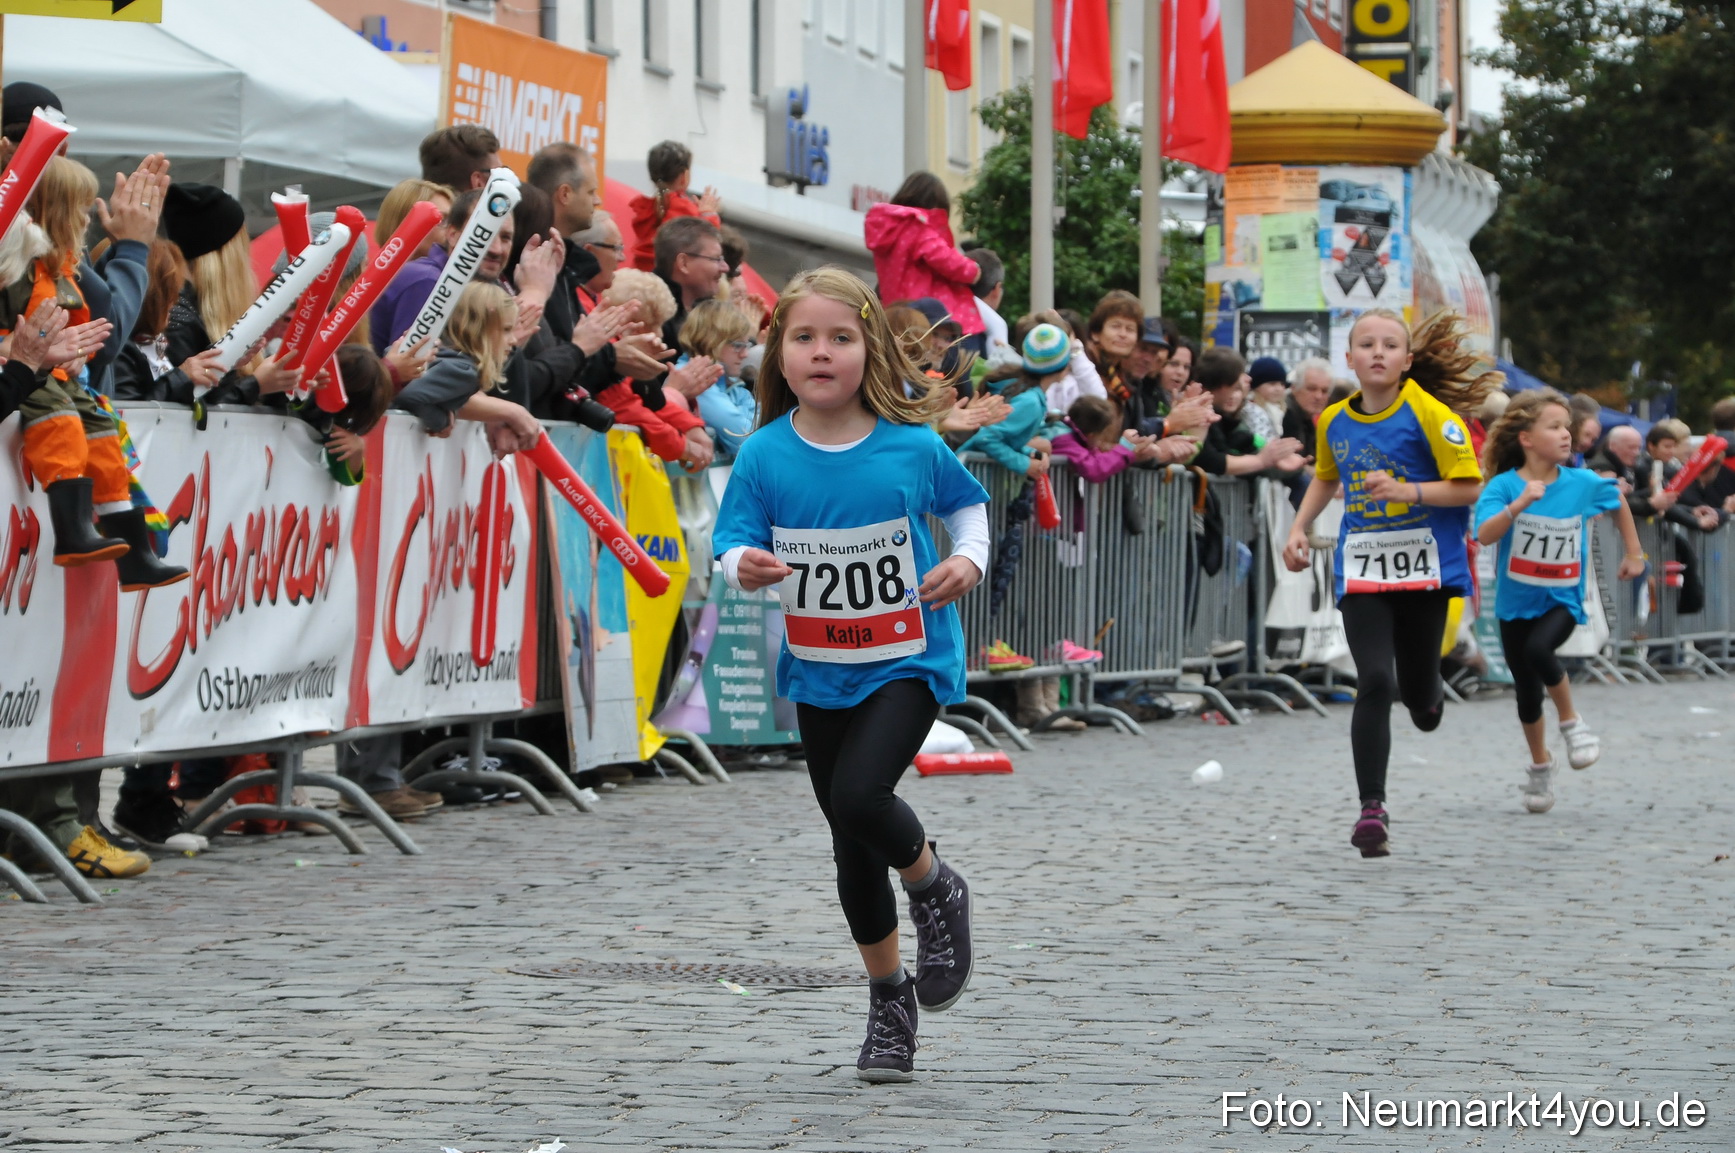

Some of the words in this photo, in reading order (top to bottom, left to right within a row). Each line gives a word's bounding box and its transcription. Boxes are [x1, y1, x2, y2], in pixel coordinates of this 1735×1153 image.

[452, 223, 493, 276] BMW
[286, 318, 308, 352] Audi
[300, 291, 320, 320] BKK
[319, 307, 348, 343] Audi
[347, 277, 373, 309] BKK
[403, 273, 463, 352] Laufspo
[559, 477, 587, 506] Audi
[583, 504, 609, 531] BKK
[775, 540, 816, 555] PARTL
[819, 537, 886, 555] Neumarkt
[1346, 541, 1376, 550] PARTL
[1376, 538, 1420, 549] Neumarkt
[1354, 548, 1431, 580] 7194
[1522, 530, 1576, 560] 7171
[785, 604, 791, 613] 3
[786, 555, 905, 611] 7208
[825, 624, 873, 648] Katja
[0, 677, 40, 729] adio
